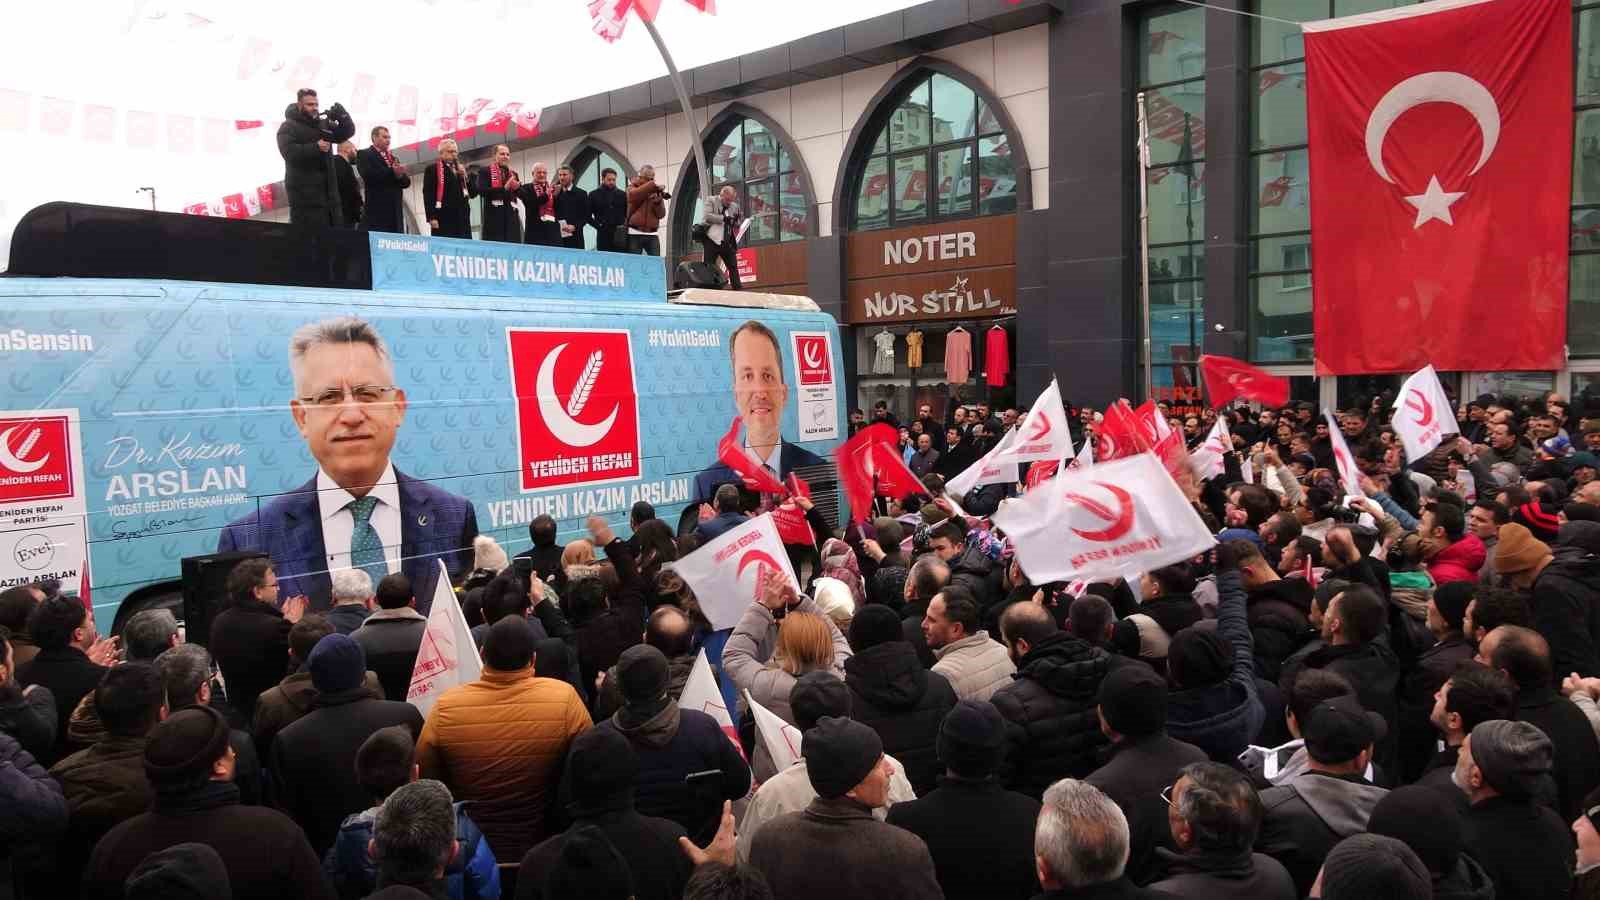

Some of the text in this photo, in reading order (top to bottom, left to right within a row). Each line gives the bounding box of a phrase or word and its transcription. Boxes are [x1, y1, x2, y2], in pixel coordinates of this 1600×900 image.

[884, 231, 976, 265] NOTER
[513, 260, 564, 284] KAZIM
[567, 263, 625, 287] ARSLAN
[864, 291, 919, 318] NUR
[648, 328, 721, 348] #VakitGeldi
[529, 453, 632, 478] YENİDEN REFAH
[34, 473, 62, 485] REFAH
[105, 464, 247, 500] ARSLAN
[36, 505, 63, 514] REFAH
[573, 486, 626, 516] KAZIM
[630, 479, 689, 507] ARSLAN
[33, 570, 77, 584] ARSLAN
